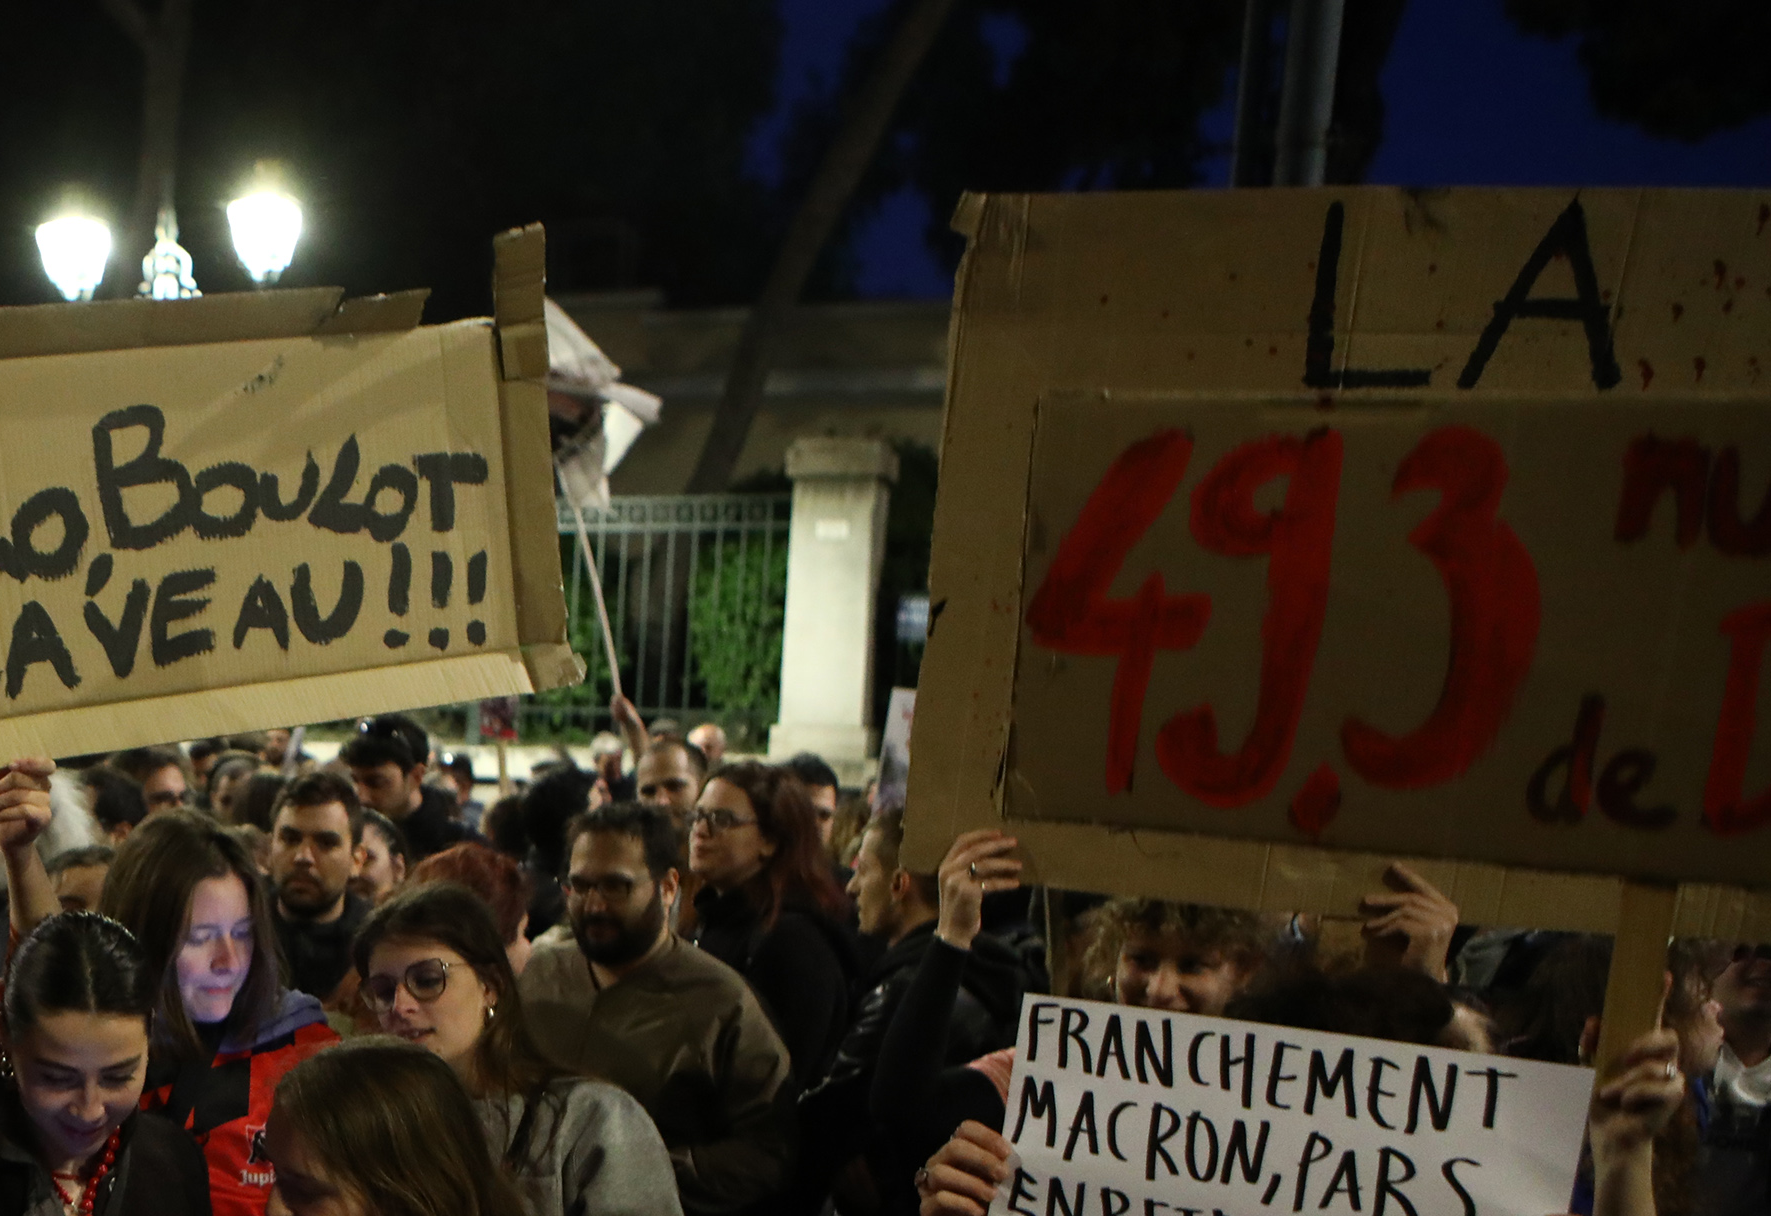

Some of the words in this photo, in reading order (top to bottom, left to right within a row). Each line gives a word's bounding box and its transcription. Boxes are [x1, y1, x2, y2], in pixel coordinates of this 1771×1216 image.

[1301, 198, 1622, 390] LA
[1525, 690, 1677, 832] de
[1027, 1002, 1519, 1136] FRANCHEMENT
[1010, 1074, 1282, 1207] MACRON,
